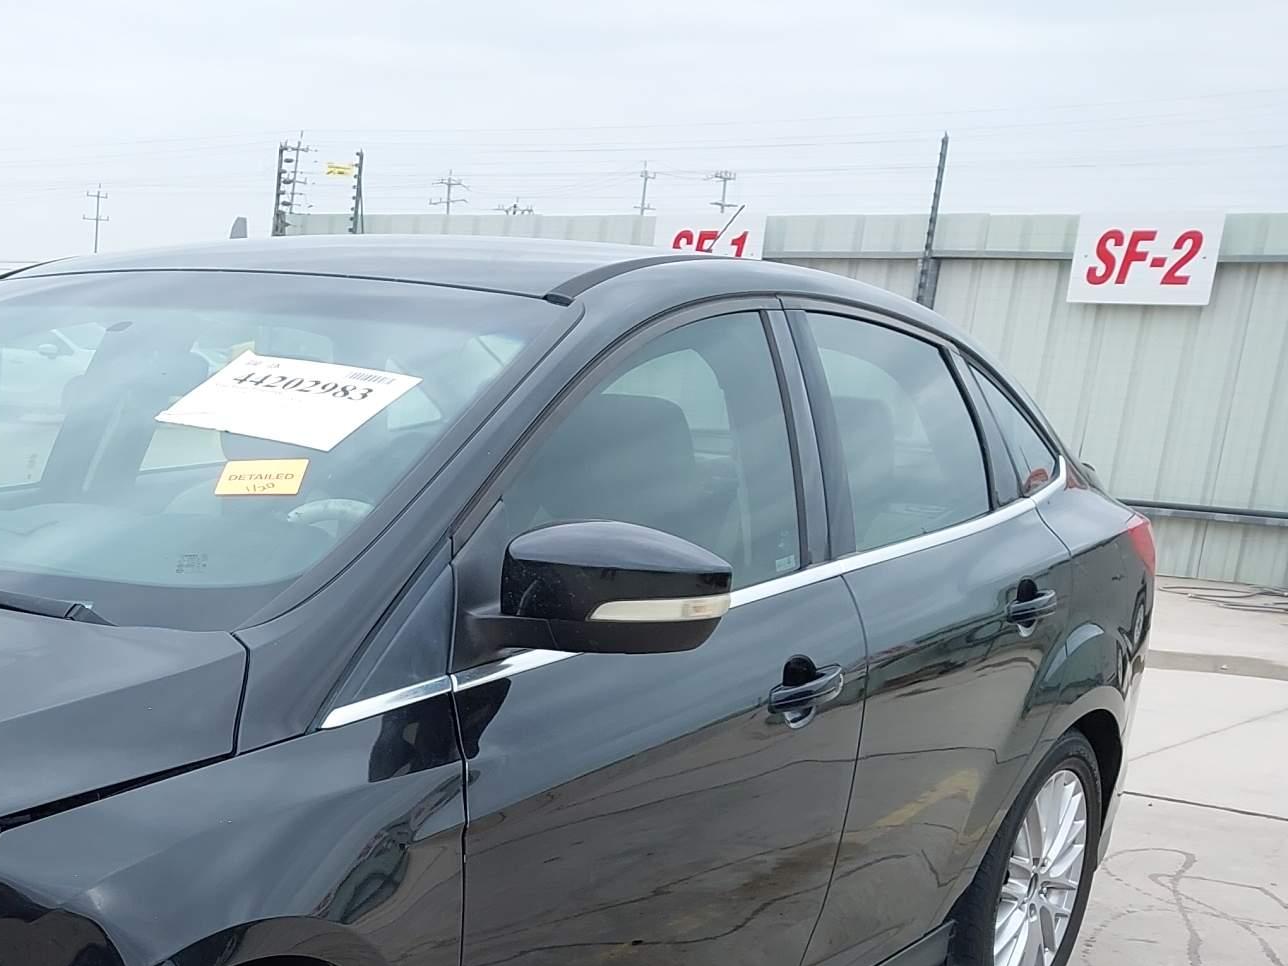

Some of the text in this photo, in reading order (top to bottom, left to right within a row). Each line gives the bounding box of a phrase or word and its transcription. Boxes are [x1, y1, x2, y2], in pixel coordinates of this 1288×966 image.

[672, 229, 749, 258] F1
[1086, 229, 1204, 286] SF-2
[232, 371, 374, 401] 44202983
[228, 472, 295, 481] DETAILED
